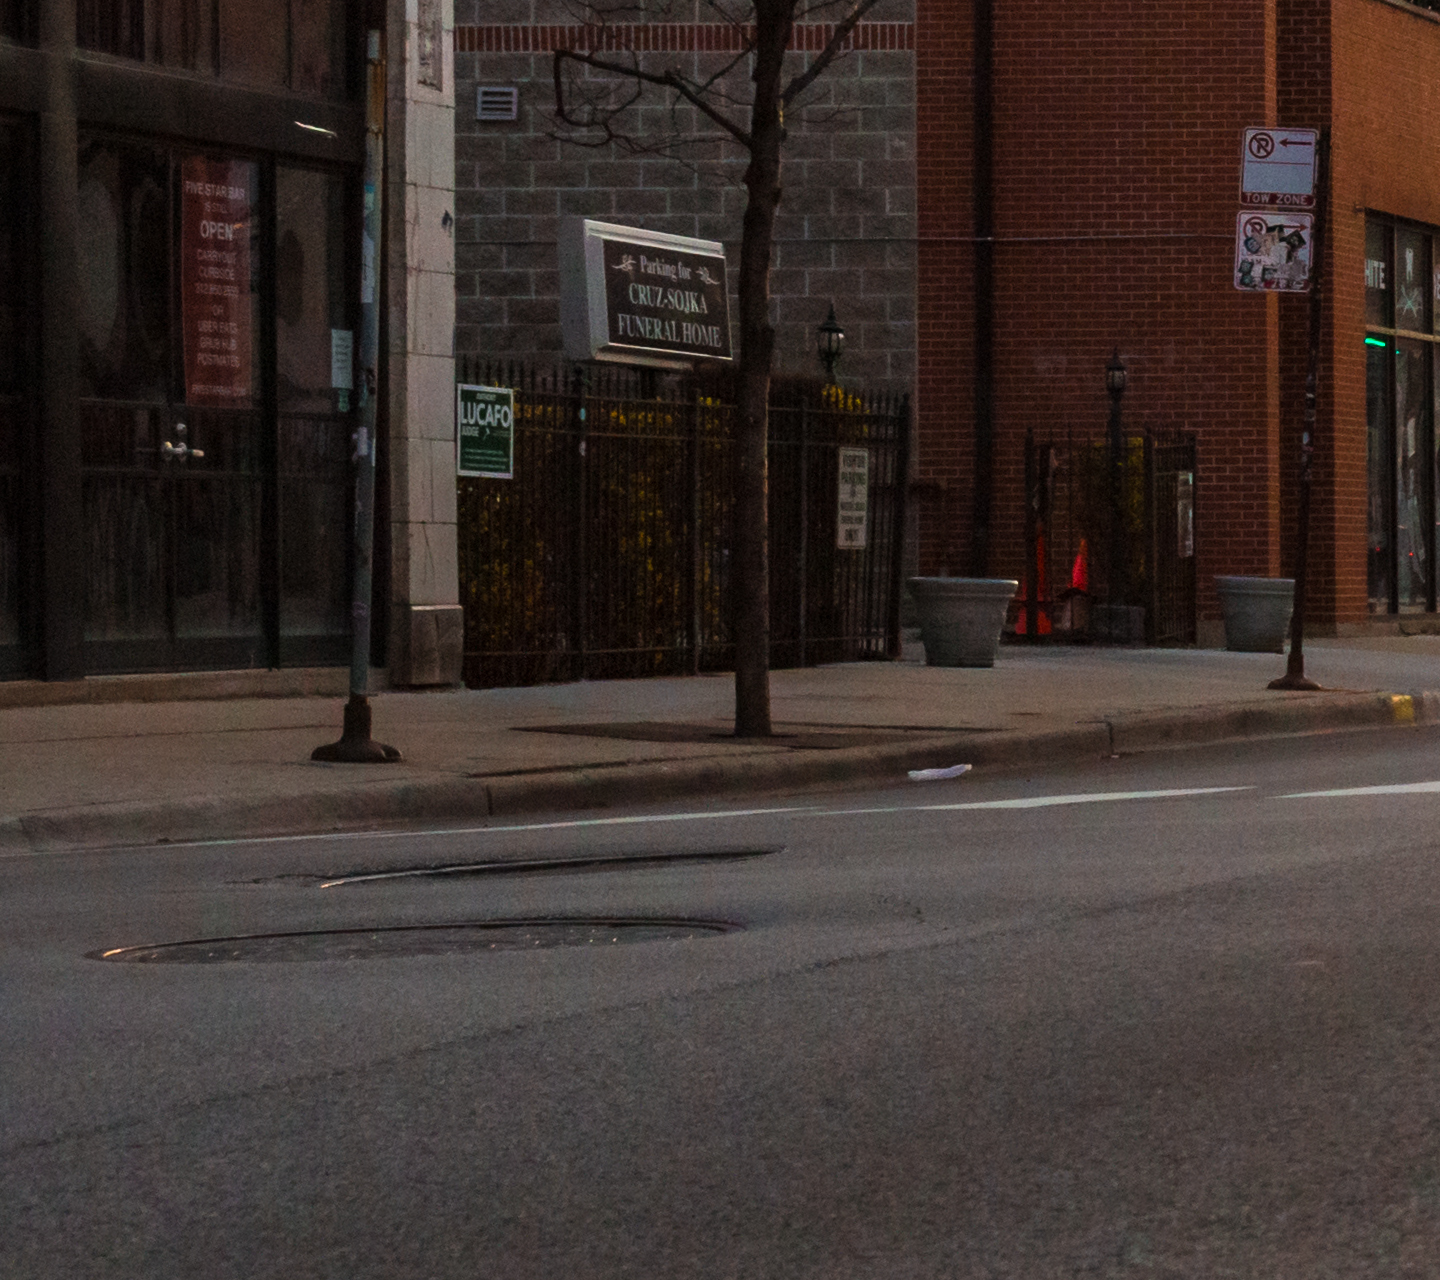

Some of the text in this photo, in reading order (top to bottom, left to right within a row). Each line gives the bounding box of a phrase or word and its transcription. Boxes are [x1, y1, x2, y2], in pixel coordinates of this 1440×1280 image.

[204, 184, 226, 198] STAR
[1246, 193, 1308, 205] TOW ZONE
[200, 220, 233, 240] OPEN
[640, 255, 692, 282] Parking for
[629, 283, 708, 314] CRUZ-SOJKA
[618, 313, 722, 348] FUNERAL HOME
[461, 401, 511, 428] LUCAFO
